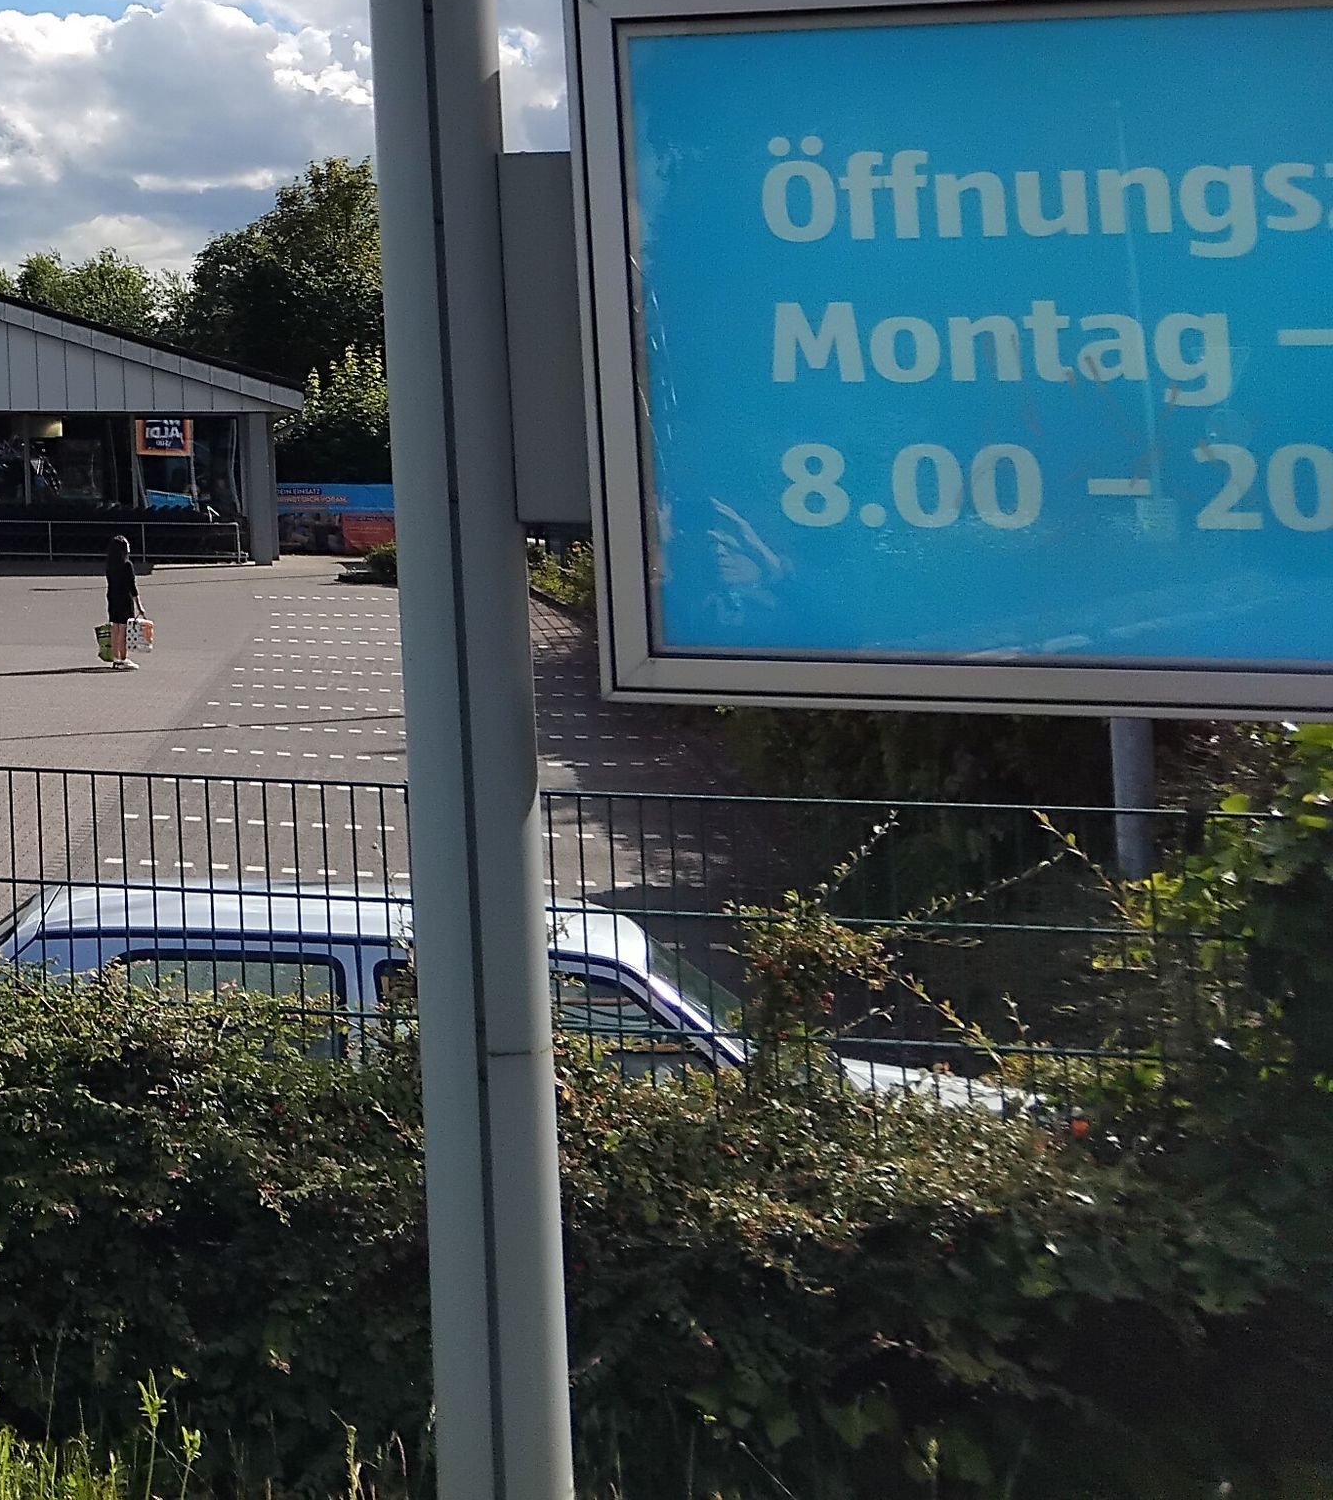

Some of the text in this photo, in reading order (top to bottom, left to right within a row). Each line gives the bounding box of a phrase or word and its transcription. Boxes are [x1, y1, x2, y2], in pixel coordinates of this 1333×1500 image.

[761, 135, 1333, 258] Öffnungs
[771, 300, 1232, 407] Montag
[780, 443, 1044, 528] 8.00
